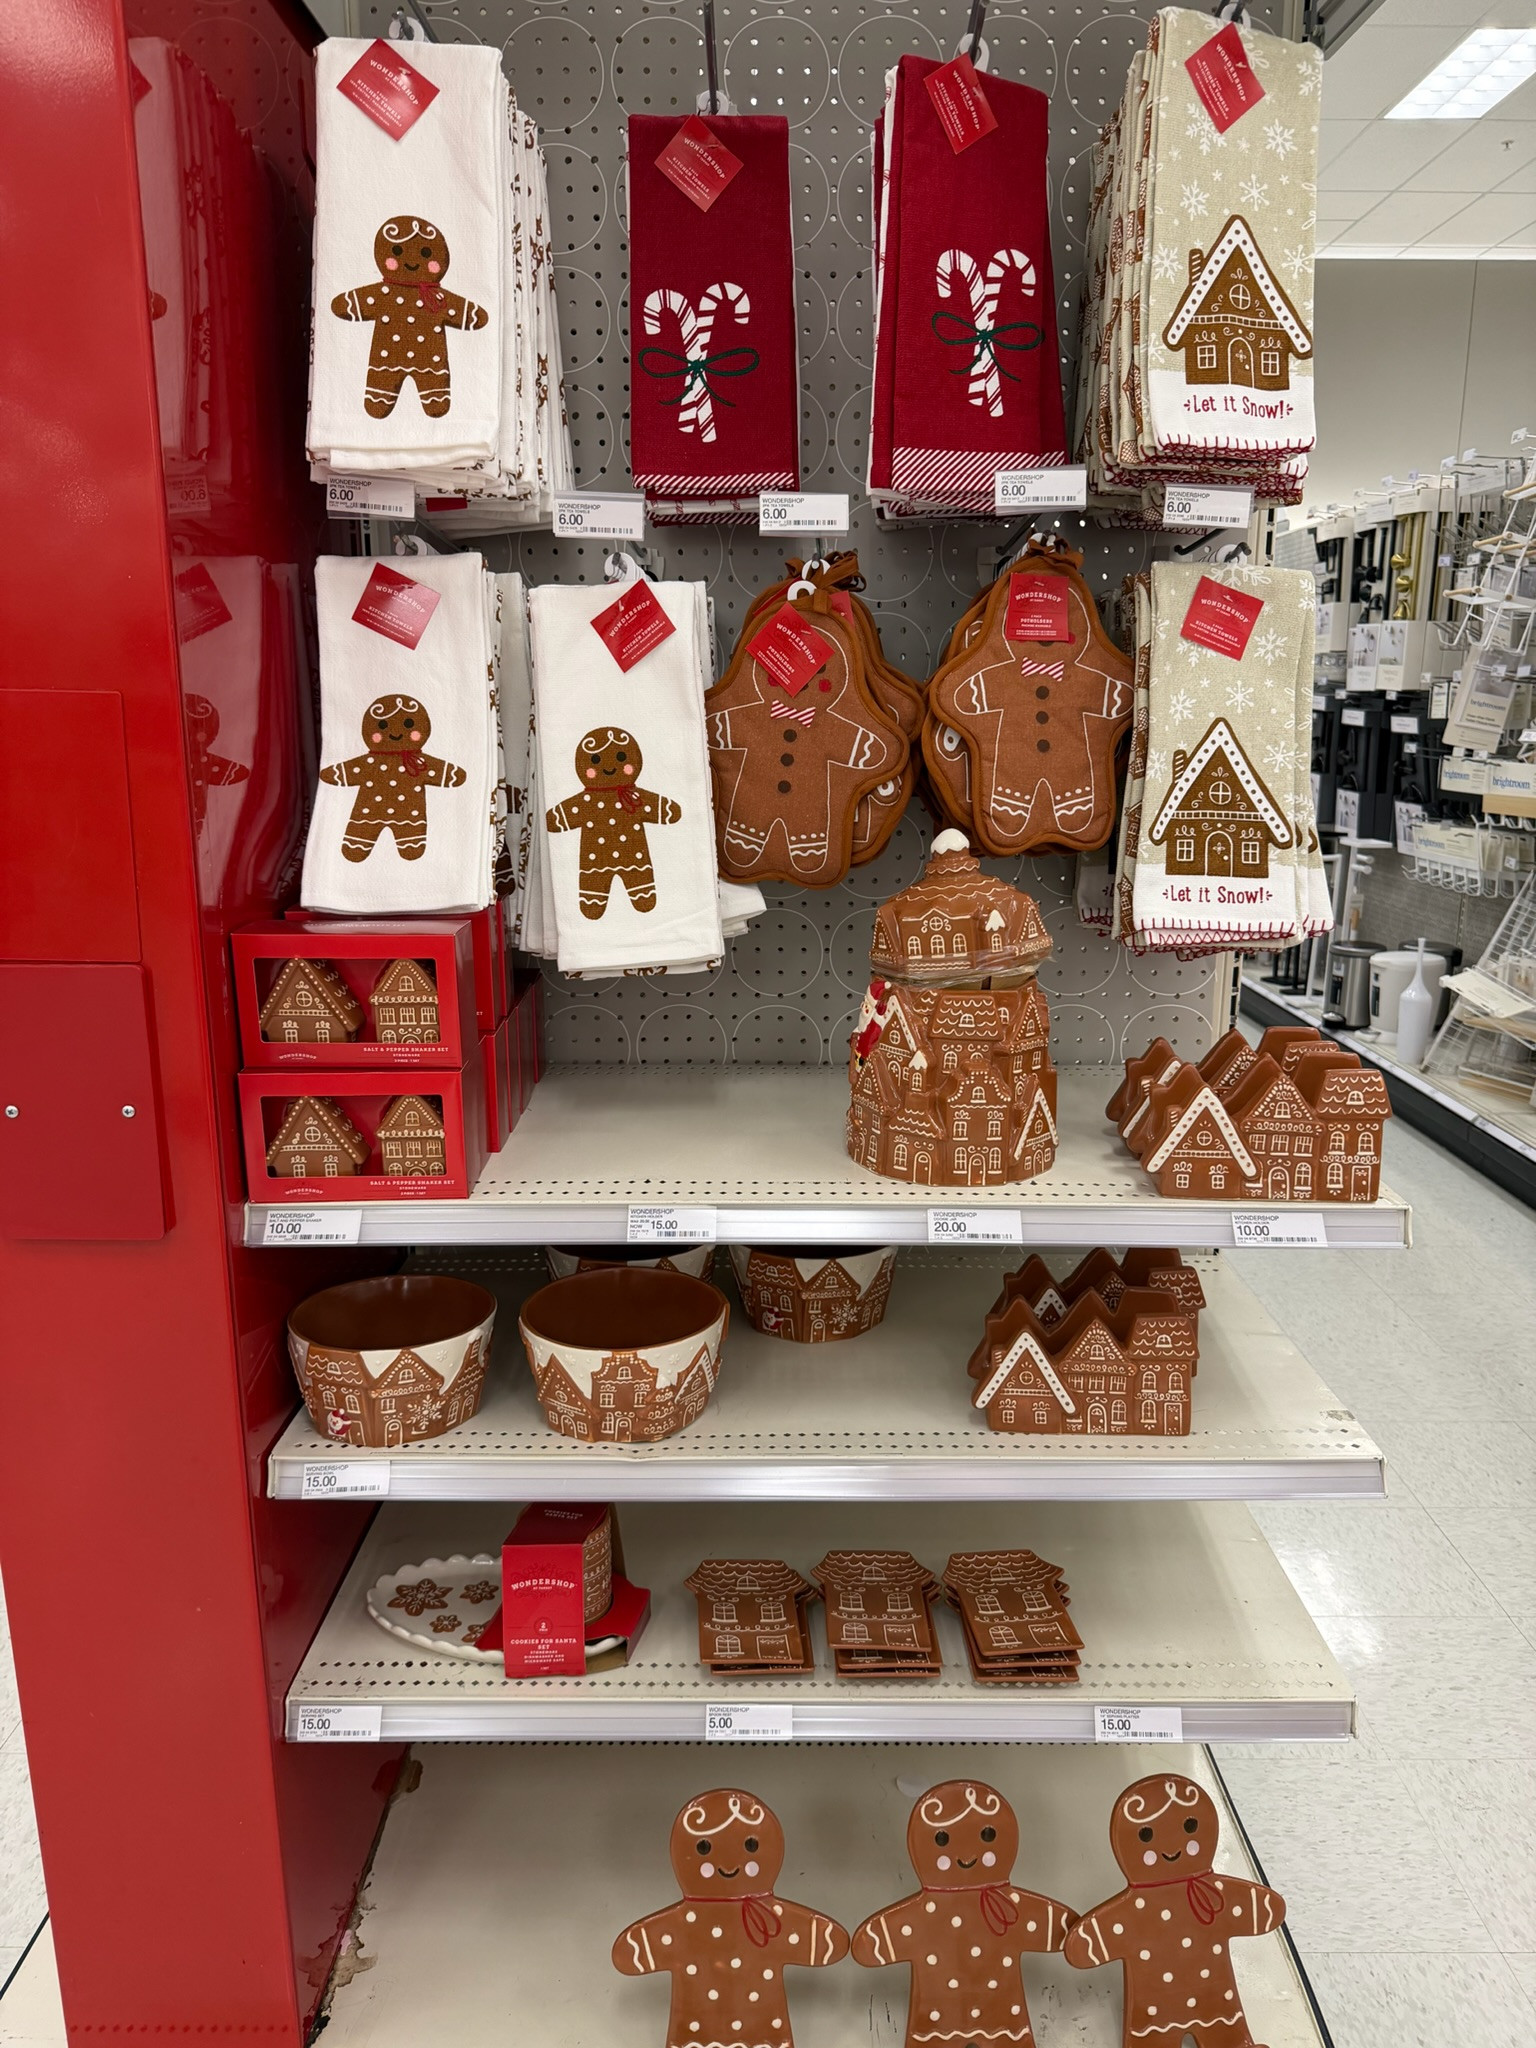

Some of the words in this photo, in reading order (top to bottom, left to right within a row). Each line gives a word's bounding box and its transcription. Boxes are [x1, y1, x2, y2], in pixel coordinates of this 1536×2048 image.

[1216, 44, 1246, 101] WONDERSHOP
[370, 60, 418, 104] WONDERSHOP
[357, 80, 380, 101] KITCHEN
[380, 100, 401, 120] TOWELS
[953, 70, 980, 130] WONDERSHOP
[684, 138, 725, 178] WONDERSHOP
[1194, 395, 1217, 412] Let
[1224, 396, 1236, 412] it
[1242, 396, 1284, 418] Snow!
[330, 478, 372, 487] WONDERSHOP
[330, 489, 354, 501] 6.00
[1002, 485, 1026, 496] 6.00
[1168, 491, 1210, 499] WONDERSHOP
[763, 508, 786, 519] 6.00
[1167, 502, 1191, 513] 6.00
[559, 514, 583, 525] 6.00
[376, 585, 425, 613] WONDERSHOP
[1015, 592, 1062, 602] WONDERSHOP
[1201, 598, 1248, 622] WONDERSHOP
[369, 606, 392, 620] KITCHEN
[392, 617, 413, 630] TOWELS
[610, 600, 650, 637] WONDERSHOP
[622, 636, 642, 652] KITCHEN
[642, 620, 660, 636] TOWELS
[1196, 620, 1218, 633] KITCHEN
[1218, 630, 1238, 642] TOWELS
[776, 623, 816, 664] WONDERSHOP
[768, 646, 794, 673] POTHOLDERS
[1492, 776, 1530, 789] brightroom
[1170, 885, 1192, 902] Let
[1199, 887, 1210, 902] it
[1218, 886, 1264, 904] Snow!
[270, 1223, 302, 1234] 10.00
[651, 1220, 678, 1230] 15.00
[934, 1222, 966, 1232] 20.00
[1237, 1225, 1270, 1236] 10.00
[306, 1476, 337, 1487] 15.00
[511, 1579, 575, 1590] WONDERSHOP
[301, 1719, 330, 1729] 15.00
[709, 1717, 732, 1728] 5.00
[1101, 1719, 1130, 1730] 15.00
